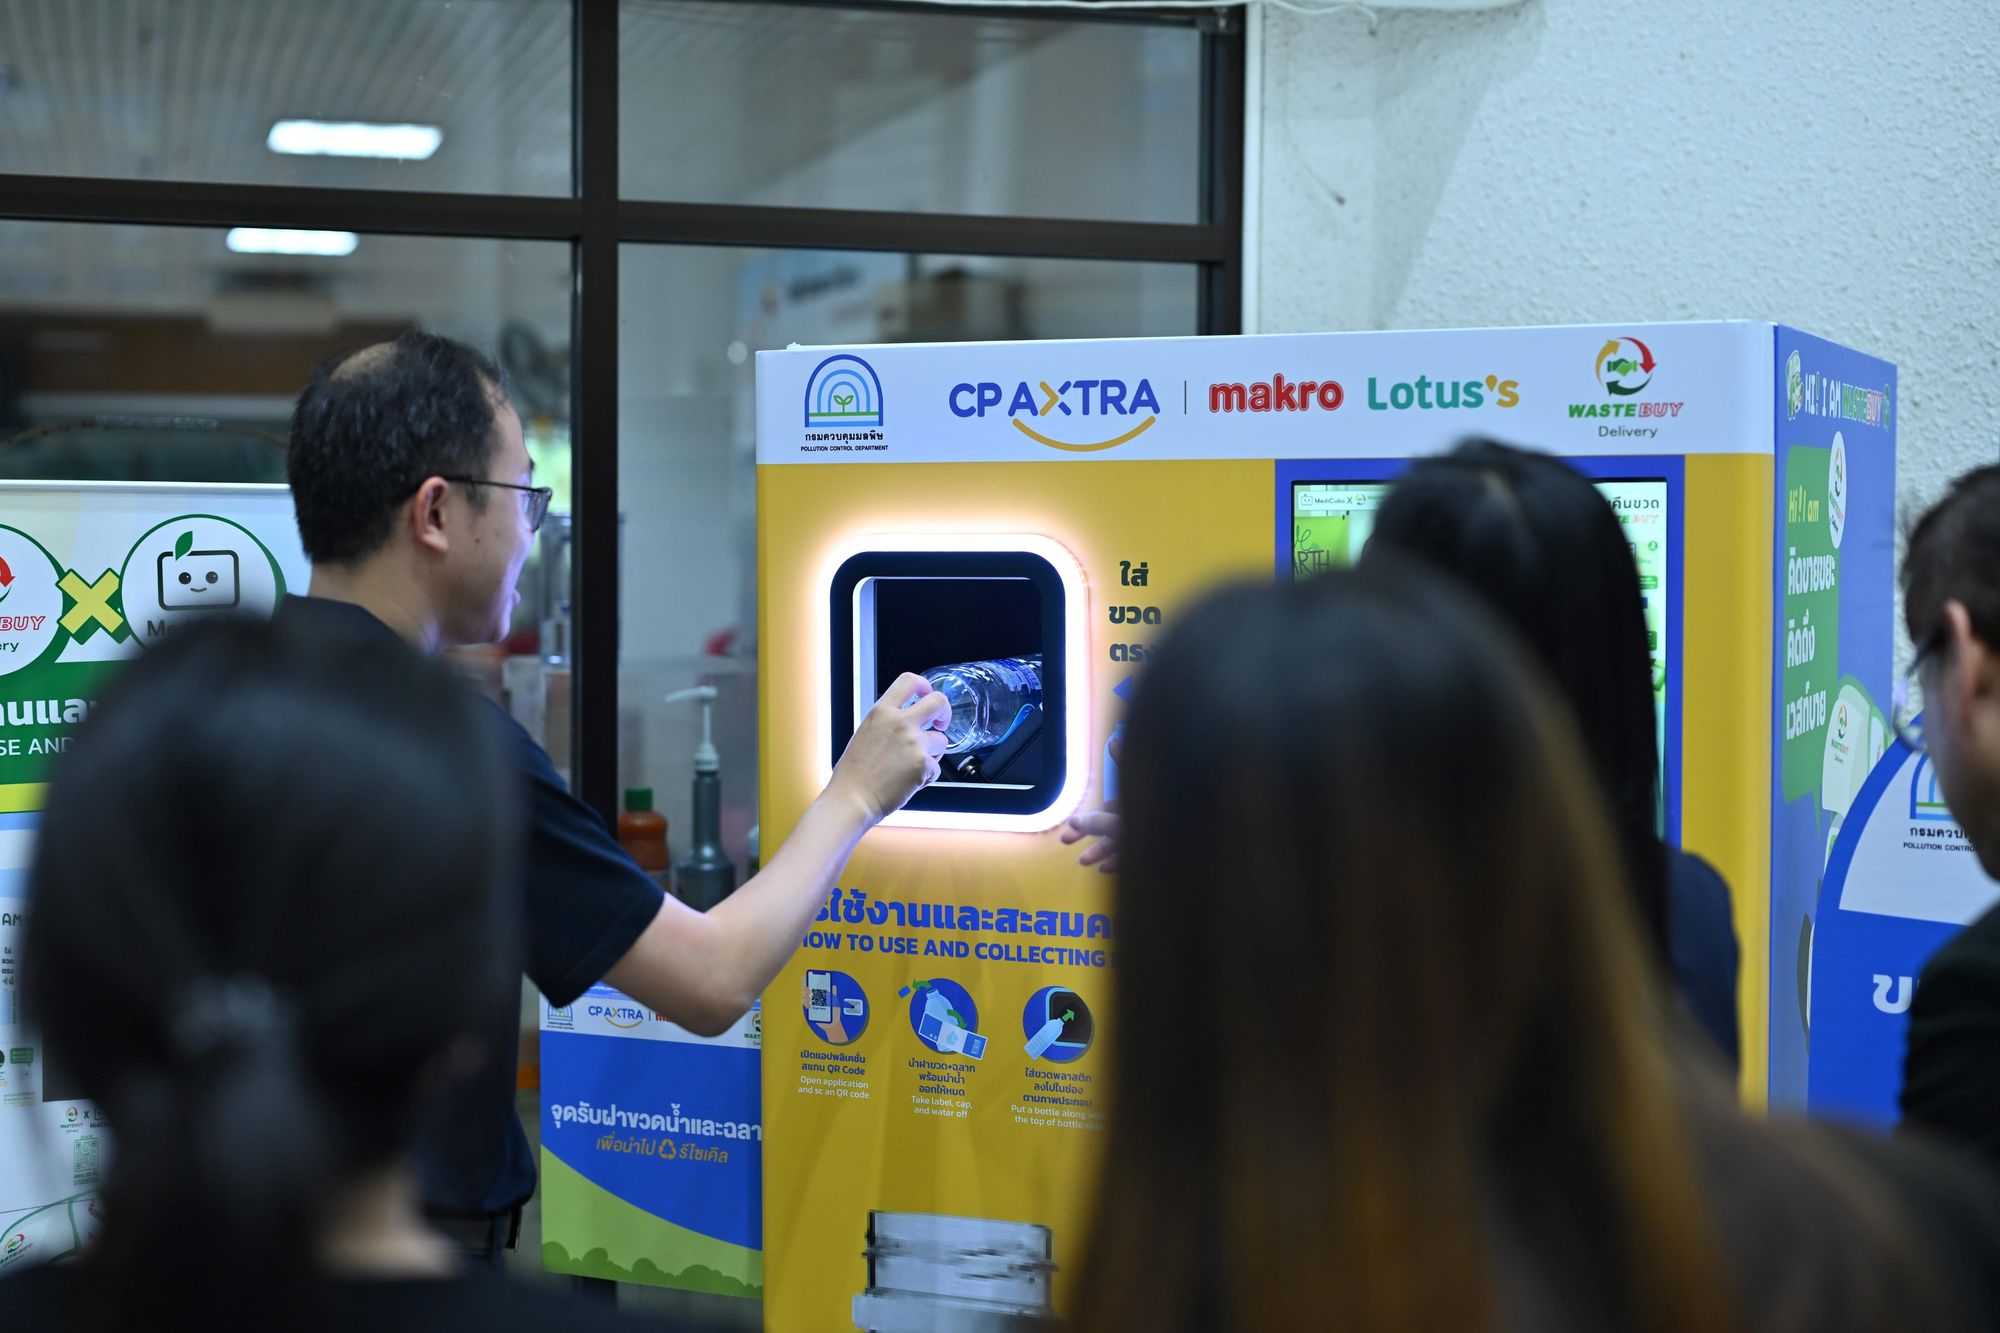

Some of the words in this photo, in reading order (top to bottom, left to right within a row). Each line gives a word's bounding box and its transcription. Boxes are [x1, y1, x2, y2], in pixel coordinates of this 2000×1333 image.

[949, 382, 1002, 417] CP
[1008, 379, 1160, 416] AXTRA
[1209, 373, 1344, 413] makro
[1368, 374, 1520, 410] Lotus's
[805, 430, 883, 444] กรมควบคุมมลพิษ
[1598, 426, 1658, 438] Delivery
[1608, 496, 1659, 509] คืนขวด
[1119, 560, 1149, 587] ใส่
[1109, 606, 1161, 625] ขวด
[0, 642, 19, 652] ry
[1903, 842, 1942, 850] POLLUTION
[1945, 844, 1976, 852] CONTRO
[847, 934, 873, 951] TO
[879, 936, 918, 955] USE
[924, 939, 969, 958] AND
[975, 942, 1106, 968] COLLECTING
[588, 1006, 602, 1016] CP
[604, 1007, 643, 1020] AXTRA
[802, 1063, 825, 1072] สแกน
[828, 1064, 840, 1074] QR
[843, 1066, 865, 1075] Code
[1025, 1067, 1092, 1082] ใส่ขวดพลาสติก
[800, 1075, 821, 1084] Open
[823, 1078, 869, 1088] application
[1034, 1082, 1084, 1094] ลงไปในช่อง
[837, 1088, 848, 1097] QR
[919, 1085, 965, 1096] ออกให้หมด
[912, 1096, 930, 1104] Take
[914, 1106, 929, 1114] and
[932, 1109, 954, 1117] water
[1011, 1104, 1026, 1113] Put
[1035, 1106, 1060, 1116] bottle
[551, 1101, 761, 1142] จุดรับฝาขวดน้ำและฉลา
[1015, 1115, 1028, 1123] the
[1030, 1117, 1044, 1127] top
[1046, 1118, 1055, 1126] of
[1058, 1120, 1083, 1129] bottle
[597, 1131, 656, 1156] เพื่อนำไป
[679, 1146, 729, 1163] รีไซเคิล
